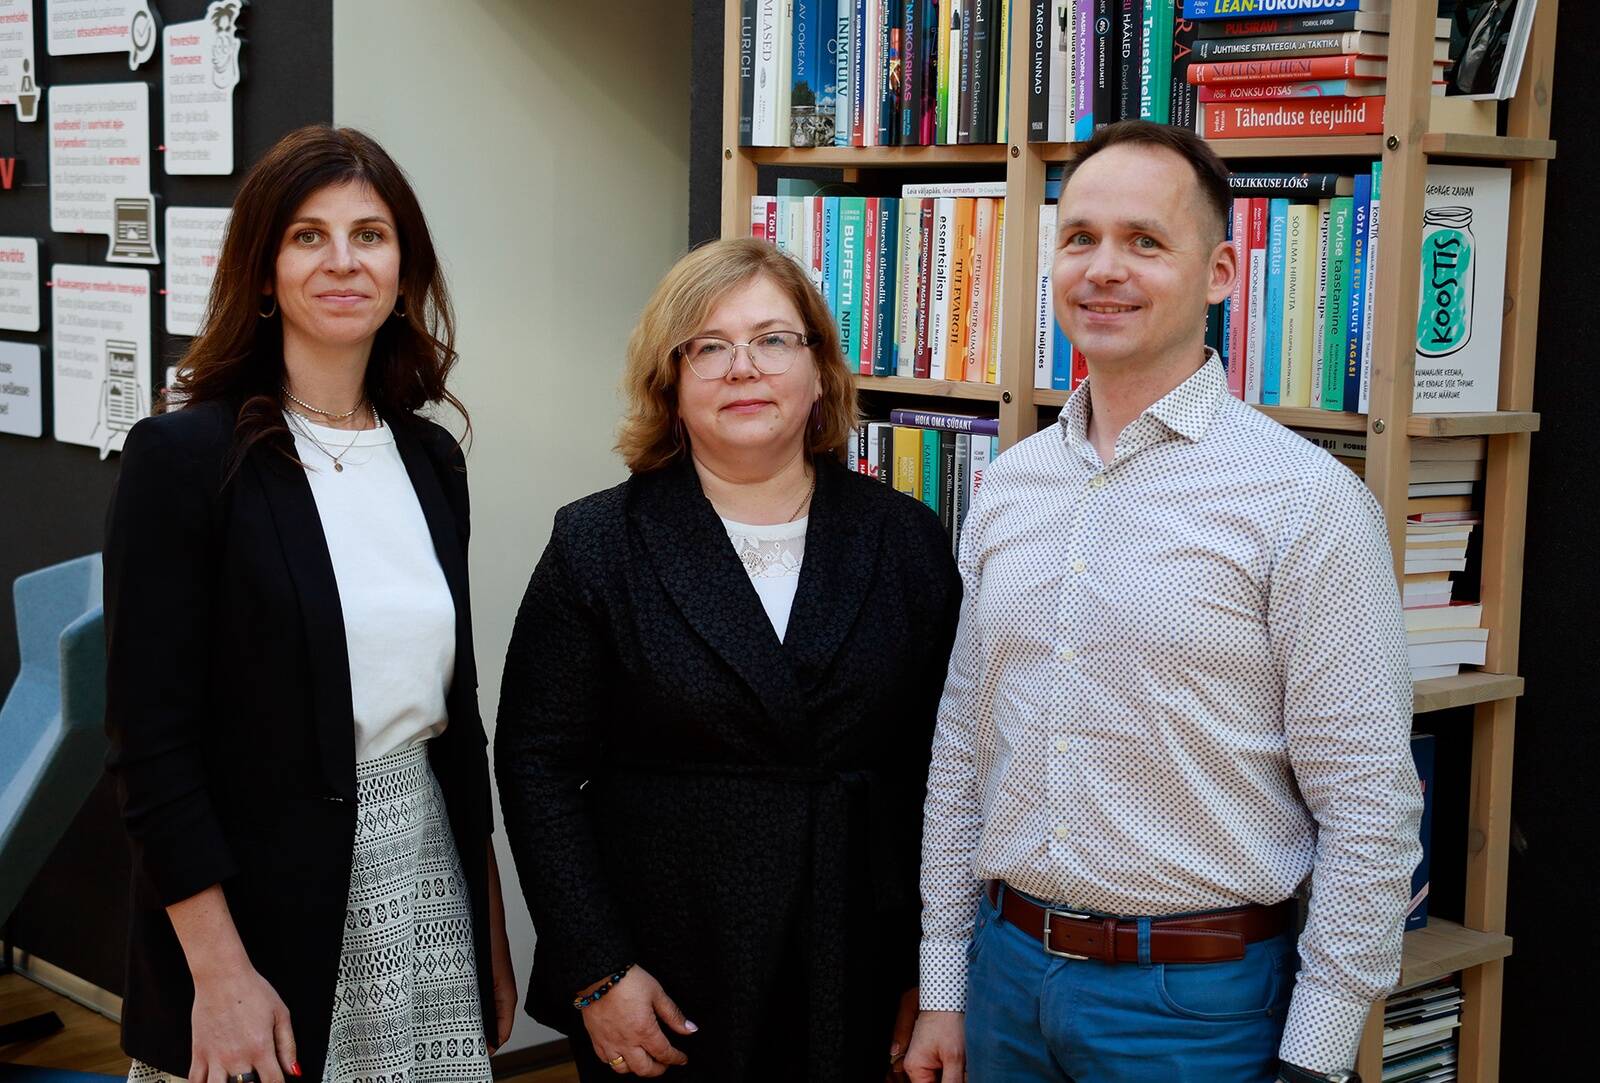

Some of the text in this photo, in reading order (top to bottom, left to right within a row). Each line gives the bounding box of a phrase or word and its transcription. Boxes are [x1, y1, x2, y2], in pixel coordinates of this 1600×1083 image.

[1214, 0, 1345, 13] LEAN-TURUNDUS
[1226, 21, 1277, 34] PULSIRAVI
[741, 16, 752, 78] LURICH
[797, 23, 806, 76] OOKEAN
[837, 17, 849, 97] INIMTULV
[855, 38, 863, 64] VÄLTIDA
[904, 4, 915, 102] NARKOÄRIKAS
[1034, 3, 1044, 95] TARGAD LINNAD
[1122, 14, 1133, 58] HÄÄLED
[1213, 44, 1250, 54] JUHTIMISE
[1252, 42, 1297, 52] STRATEEGIA
[1308, 40, 1339, 48] TAKTIKA
[972, 50, 982, 126] David Christian
[1121, 65, 1129, 90] David
[1141, 17, 1153, 117] Taustahelid
[1230, 86, 1292, 98] KONKSU OTSAS
[854, 65, 862, 126] KLIIMAKATASTROOFI
[1235, 103, 1366, 130] Tähenduse teejuhid
[1228, 177, 1282, 188] USLIKKUSE
[1425, 184, 1474, 197] GEORGE ZAIDAN
[824, 238, 831, 247] JA
[1235, 213, 1243, 233] MEIE
[1271, 216, 1285, 275] Kurnatus
[1370, 207, 1380, 239] KOOSTIS
[842, 225, 855, 305] BUFFETTI
[878, 211, 889, 304] Elutervelt ülipüüdlik
[921, 228, 929, 284] EMOTSIONAALSE
[936, 216, 947, 301] essentsialism
[974, 254, 982, 297] PETLIKUD
[1288, 239, 1299, 310] ILMA HIRMUTA
[1330, 208, 1348, 335] Tervise taastamine
[901, 263, 910, 344] IMMUUNSÜSTEEM
[1318, 296, 1329, 318] laps
[1349, 206, 1365, 377] VÕTA OMA ELU VALULT TAGASI
[1431, 238, 1460, 343] KOOSTIS
[841, 311, 851, 355] NIPID
[918, 310, 926, 337] PÄRSSIV
[969, 301, 979, 365] PISITRAUMAD
[1037, 276, 1048, 369] Nartsissisti hüljates
[1248, 255, 1259, 391] KROONILISEST VALUST VABAKS
[915, 415, 972, 431] HOIA OMA SÜDANT
[923, 444, 931, 496] KAHETSUSE
